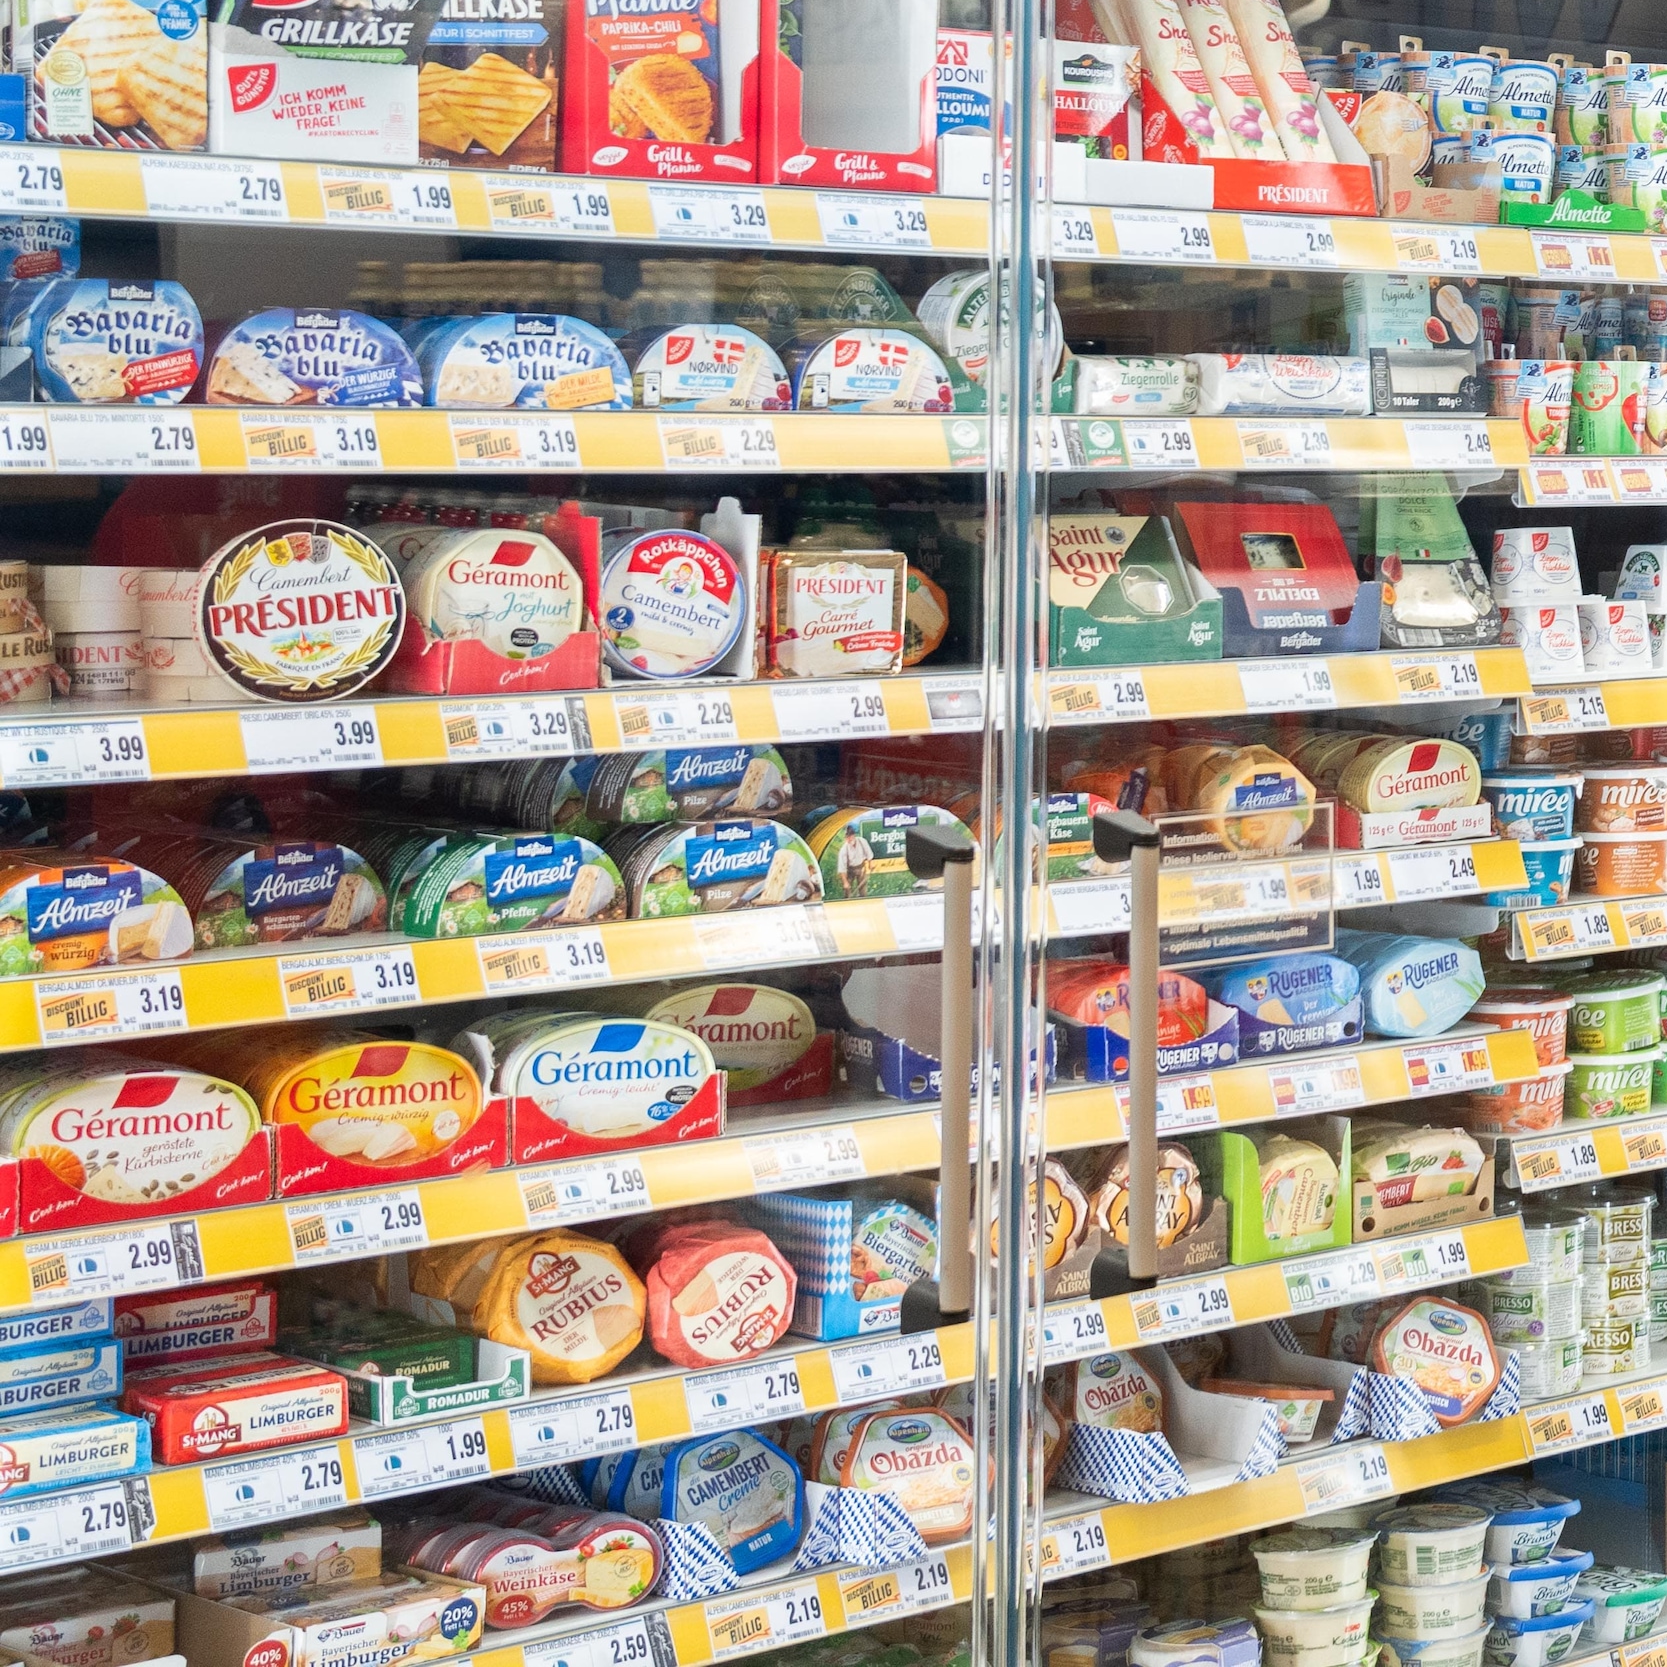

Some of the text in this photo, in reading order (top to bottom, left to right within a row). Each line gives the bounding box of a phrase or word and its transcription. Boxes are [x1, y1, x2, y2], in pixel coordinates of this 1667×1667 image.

[261, 17, 414, 45] GRILLKÄSE
[279, 84, 347, 106] ICH KOMM
[329, 97, 366, 113] KEINE
[1520, 107, 1543, 118] NATUR
[647, 145, 693, 164] Grill &
[18, 164, 64, 190] 2.79
[657, 160, 703, 178] Pfanne
[240, 177, 282, 202] 2.79
[346, 190, 384, 210] BILLIG
[413, 186, 452, 209] 1.99
[1258, 184, 1329, 204] PRÉSIDENT
[733, 204, 766, 227] 3.29
[1545, 200, 1612, 224] Almette
[1180, 227, 1210, 246] 2.99
[1451, 239, 1477, 259] 2.19
[66, 308, 192, 340] Bavaria
[108, 332, 151, 356] blu
[255, 330, 378, 362] Bavaria
[296, 355, 339, 378] blu
[340, 367, 396, 387] DER WÜRZIGE
[689, 361, 738, 376] NØRVIND
[1120, 372, 1179, 388] Ziegenrolle
[1393, 395, 1419, 407] 10 Taler
[152, 428, 195, 451] 2.79
[249, 430, 286, 445] DISCOUNT
[268, 436, 307, 458] BILLIG
[337, 428, 377, 452] 3.19
[1464, 433, 1491, 453] 2.49
[638, 538, 726, 589] Rotkäppchen
[249, 565, 352, 592] Camembert
[796, 573, 886, 596] PRÉSIDENT
[1254, 587, 1320, 602] EDELPILZ
[209, 586, 399, 638] PRÉSIDENT
[621, 584, 721, 631] Camembert
[819, 610, 858, 625] Carré
[802, 618, 874, 641] Gourmet
[1187, 628, 1214, 646] Agur
[1191, 621, 1209, 631] Saint
[1410, 673, 1434, 691] BILLIG
[1451, 662, 1478, 684] 2.19
[1114, 682, 1144, 703] 2.99
[698, 701, 733, 726] 2.29
[1579, 697, 1604, 715] 2.15
[334, 721, 374, 746] 3.99
[100, 735, 144, 762] 3.99
[671, 752, 749, 786] Almzeit
[1378, 763, 1471, 799] Géramont
[1398, 819, 1458, 836] Géramont
[691, 841, 773, 877] Almzeit
[1450, 858, 1476, 878] 2.49
[32, 890, 136, 931] Almzeit
[1546, 925, 1569, 946] BILLIG
[1584, 914, 1610, 935] 1.89
[50, 945, 95, 962] würzig
[1169, 937, 1210, 953] optimale
[1268, 964, 1333, 998] RÜGENER
[1403, 952, 1458, 990] RÜGENER
[139, 985, 182, 1013] 3.19
[66, 1000, 108, 1027] BILLIG
[532, 1049, 698, 1085] Géramont
[289, 1071, 465, 1111] Géramont
[50, 1105, 233, 1143] Géramont
[142, 1140, 196, 1153] geröstete
[123, 1149, 203, 1175] Kürbiskerne
[128, 1240, 173, 1270] 2.99
[1438, 1241, 1466, 1265] 1.99
[1407, 1261, 1427, 1276] BIO
[1493, 1296, 1531, 1312] BRESSO
[1401, 1327, 1483, 1367] Obazda
[426, 1386, 490, 1410] ROMADUR
[249, 1401, 335, 1429] LIMBURGER
[446, 1431, 486, 1461] 1.99
[869, 1444, 963, 1475] Obazda
[301, 1459, 343, 1490] 2.79
[687, 1451, 771, 1507] CAMEMBERT
[718, 1475, 761, 1511] Creme
[786, 1595, 822, 1626] 2.19
[729, 1616, 763, 1645] BILLIG
